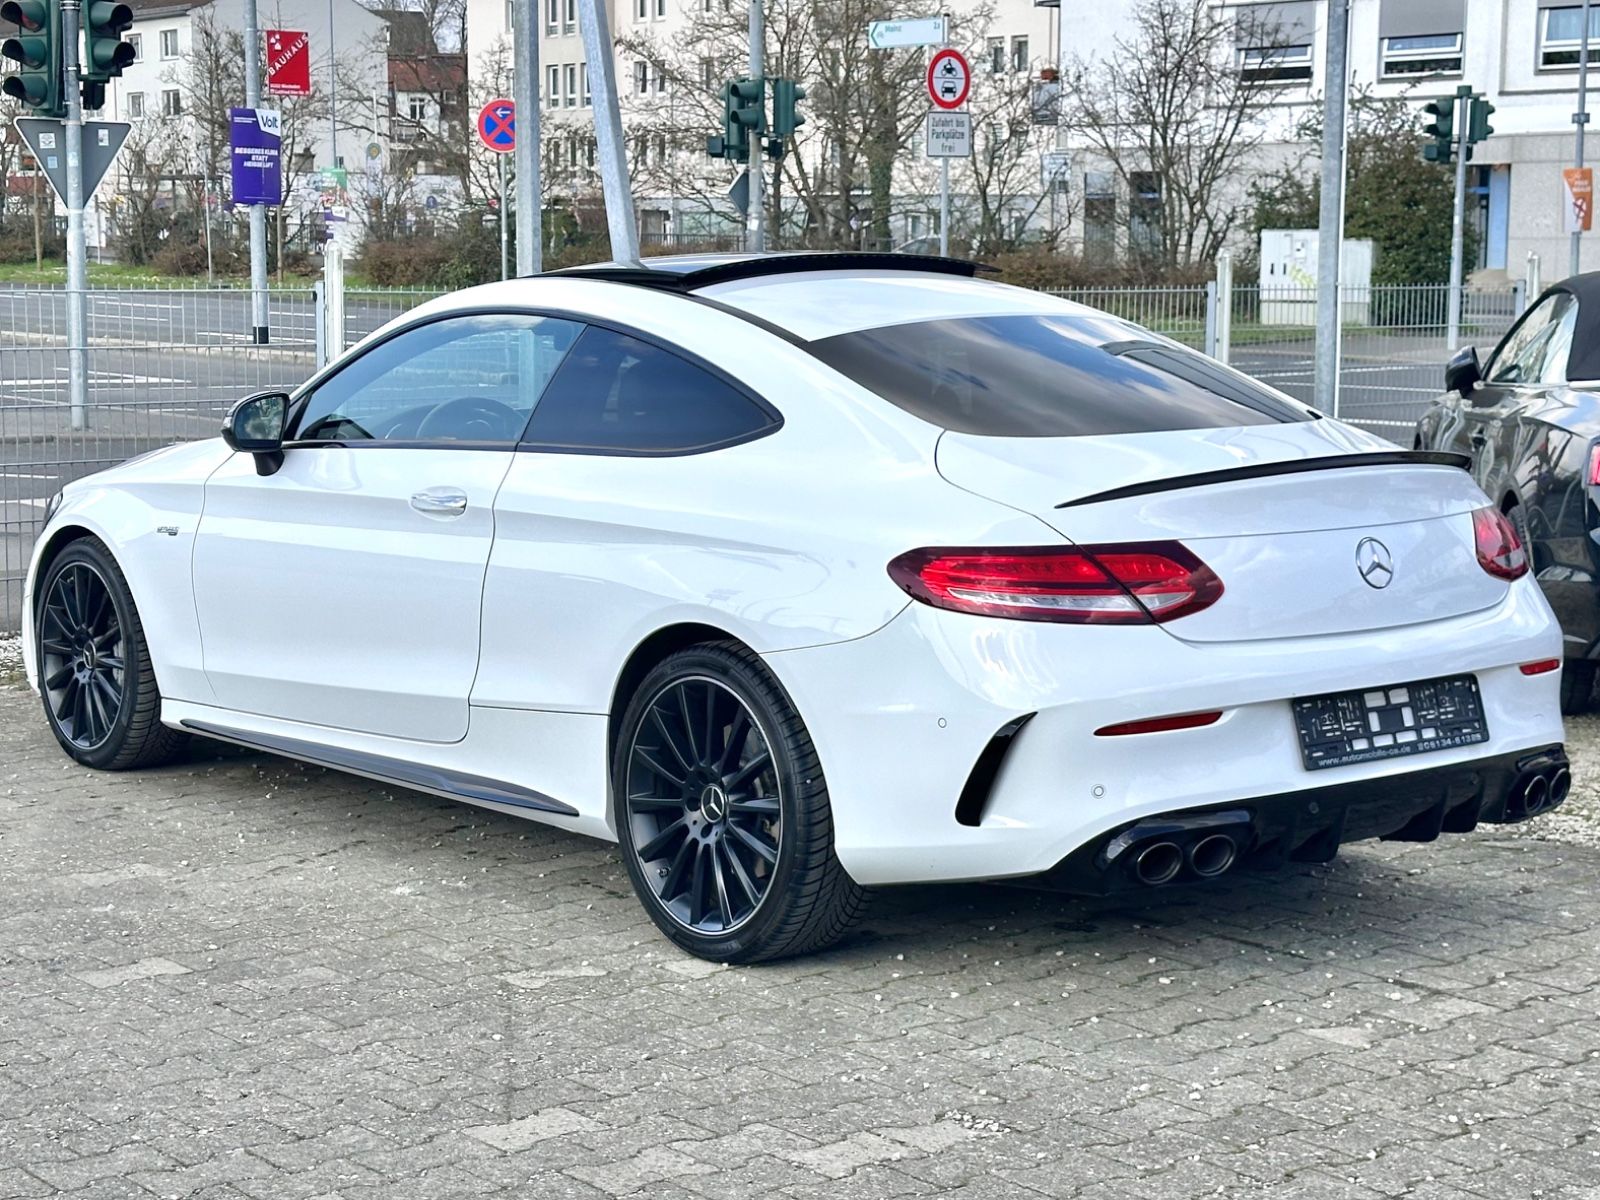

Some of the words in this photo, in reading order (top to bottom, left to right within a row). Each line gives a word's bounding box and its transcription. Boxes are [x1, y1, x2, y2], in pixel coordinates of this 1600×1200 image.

[268, 33, 309, 76] BAUHAUS
[261, 115, 279, 129] Volt
[931, 117, 954, 128] Zufahrt
[955, 117, 966, 128] bis
[931, 129, 965, 142] Parkplätze
[941, 142, 956, 153] frei
